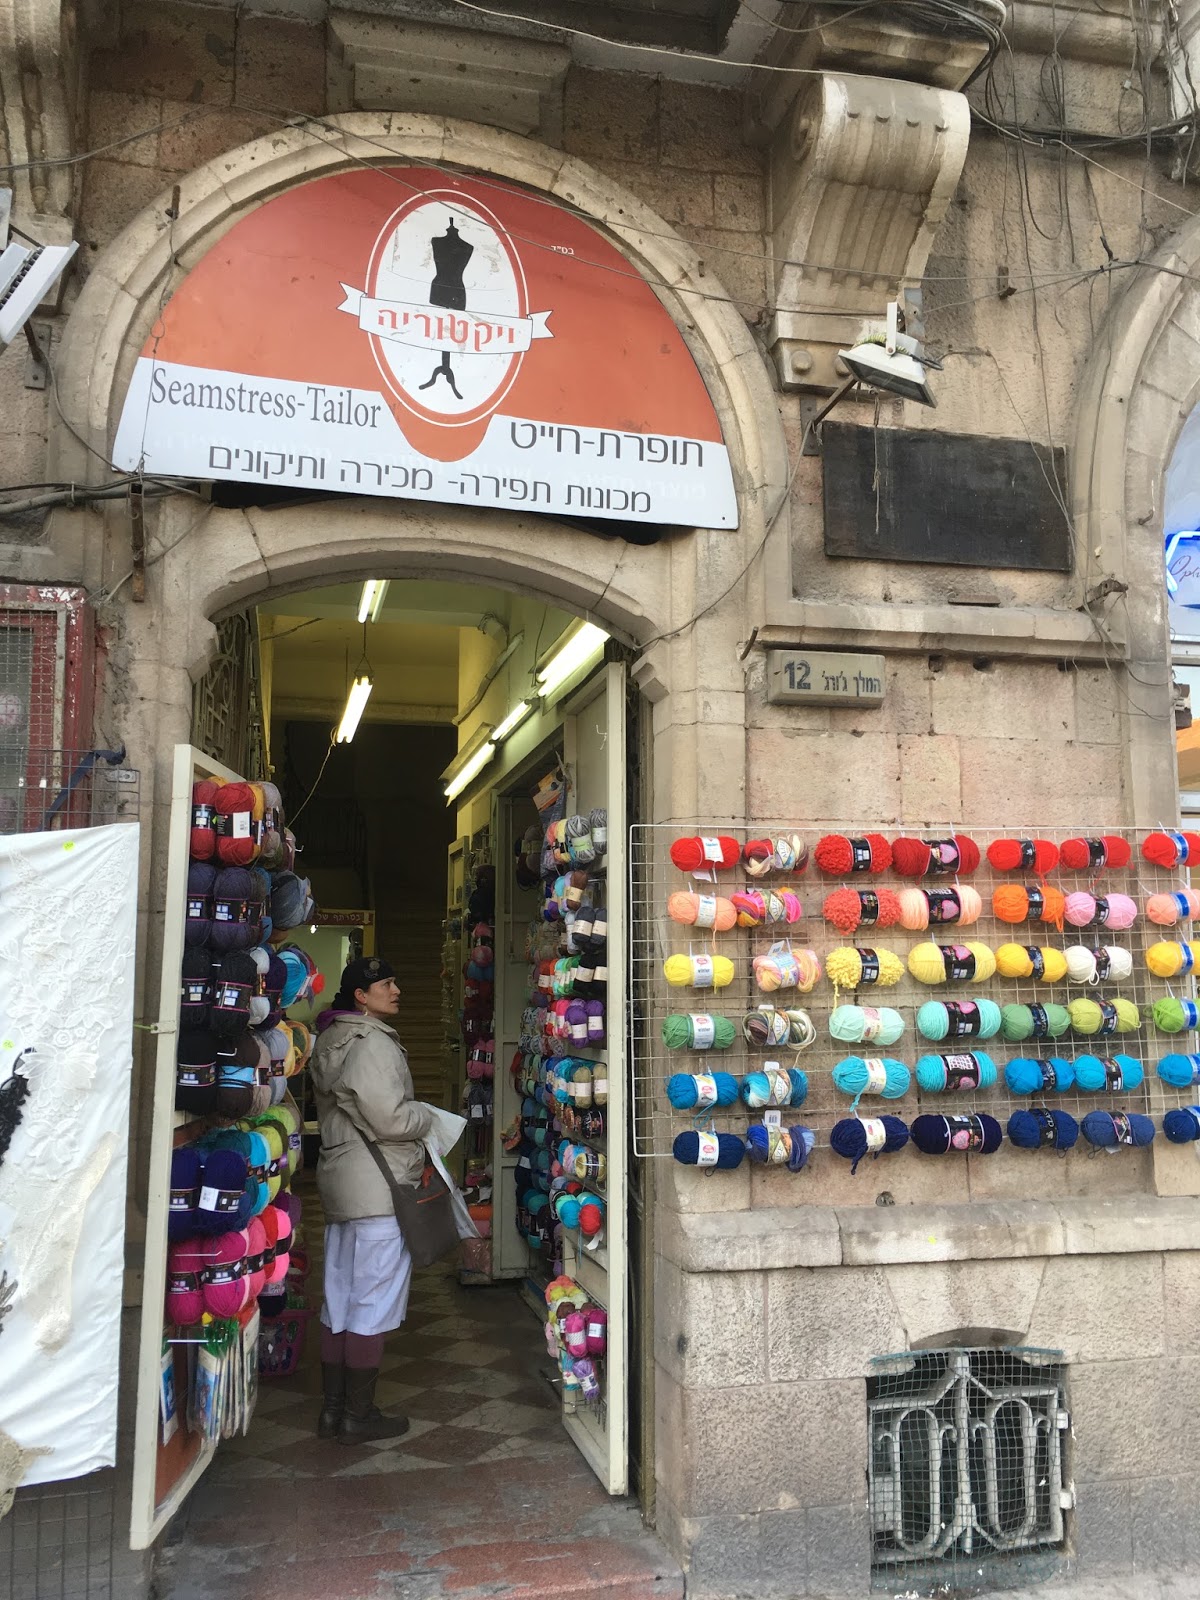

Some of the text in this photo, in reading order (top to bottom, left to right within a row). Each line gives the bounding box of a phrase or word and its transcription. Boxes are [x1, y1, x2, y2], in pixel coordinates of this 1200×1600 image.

[378, 309, 515, 352] ויקטוריה
[152, 368, 382, 428] Seamstress-Tailor
[511, 421, 703, 468] תופרת-חייט
[209, 446, 325, 481] ותיקונים
[340, 460, 433, 492] מכירה
[564, 484, 651, 513] מכונות
[784, 660, 811, 690] 12
[853, 670, 881, 697] המלך
